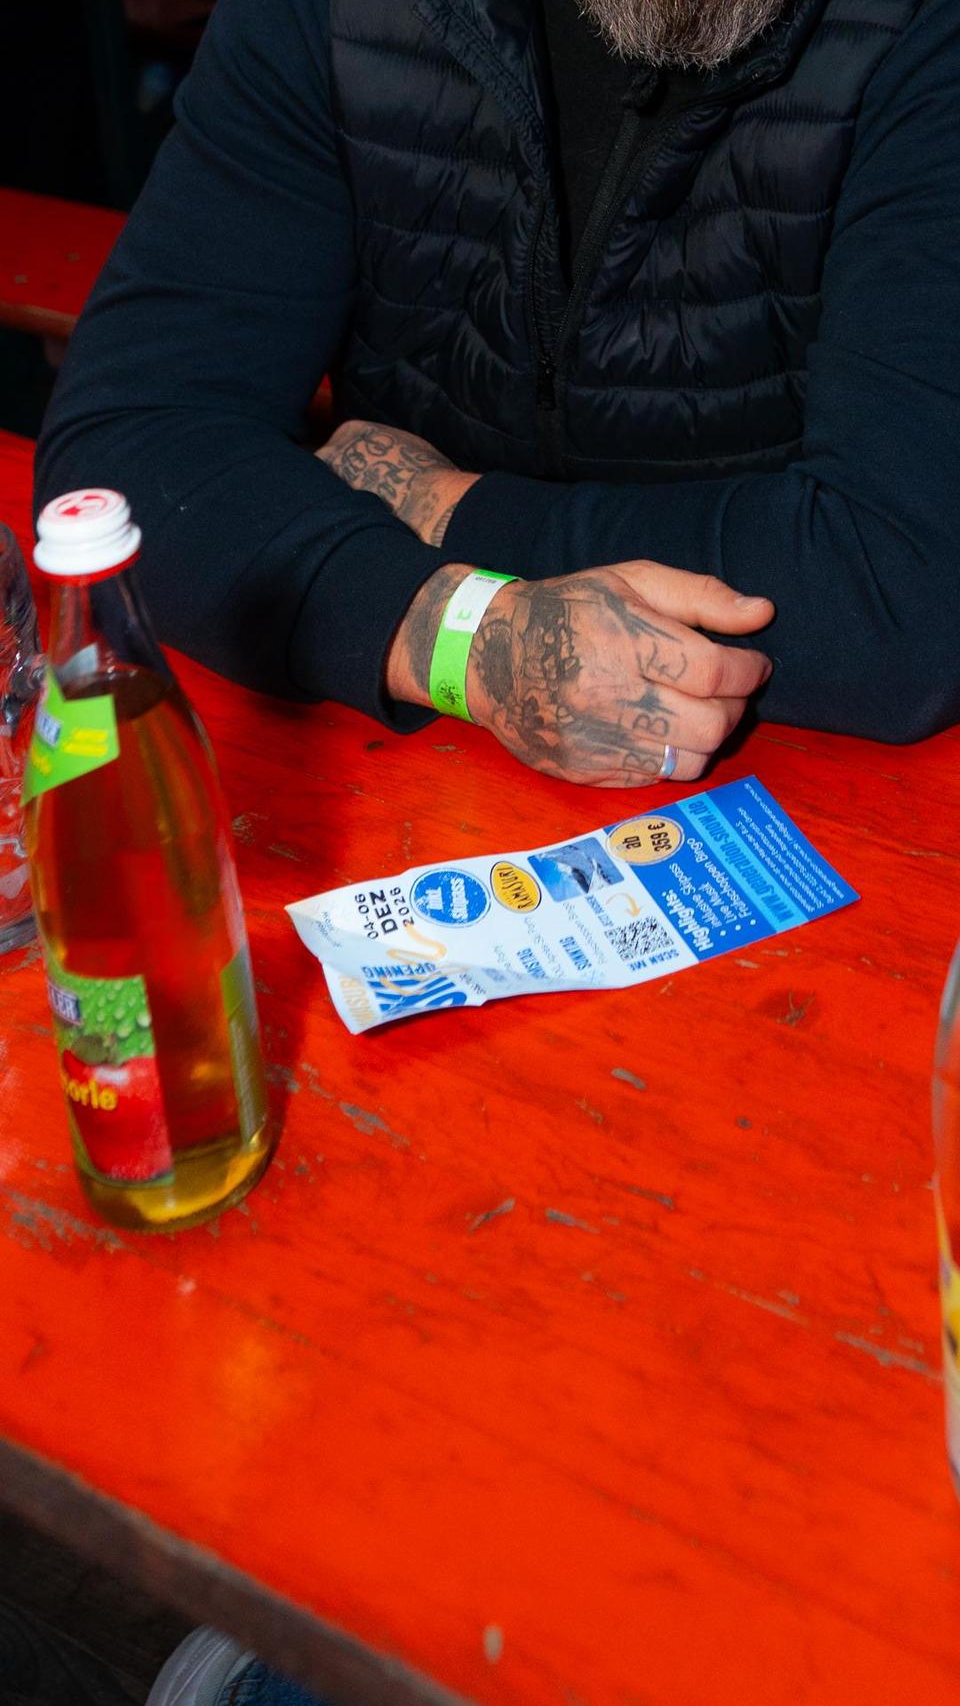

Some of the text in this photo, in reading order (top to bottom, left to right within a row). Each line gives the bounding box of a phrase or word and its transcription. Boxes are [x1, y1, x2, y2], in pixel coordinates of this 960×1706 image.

[646, 821, 673, 853] 359 €
[685, 837, 711, 863] Bingo
[688, 799, 795, 924] www.generation-snow.de
[355, 893, 379, 940] 04-06
[369, 889, 399, 935] DEZ
[390, 886, 415, 928] 2026
[661, 890, 715, 953] Highlights:
